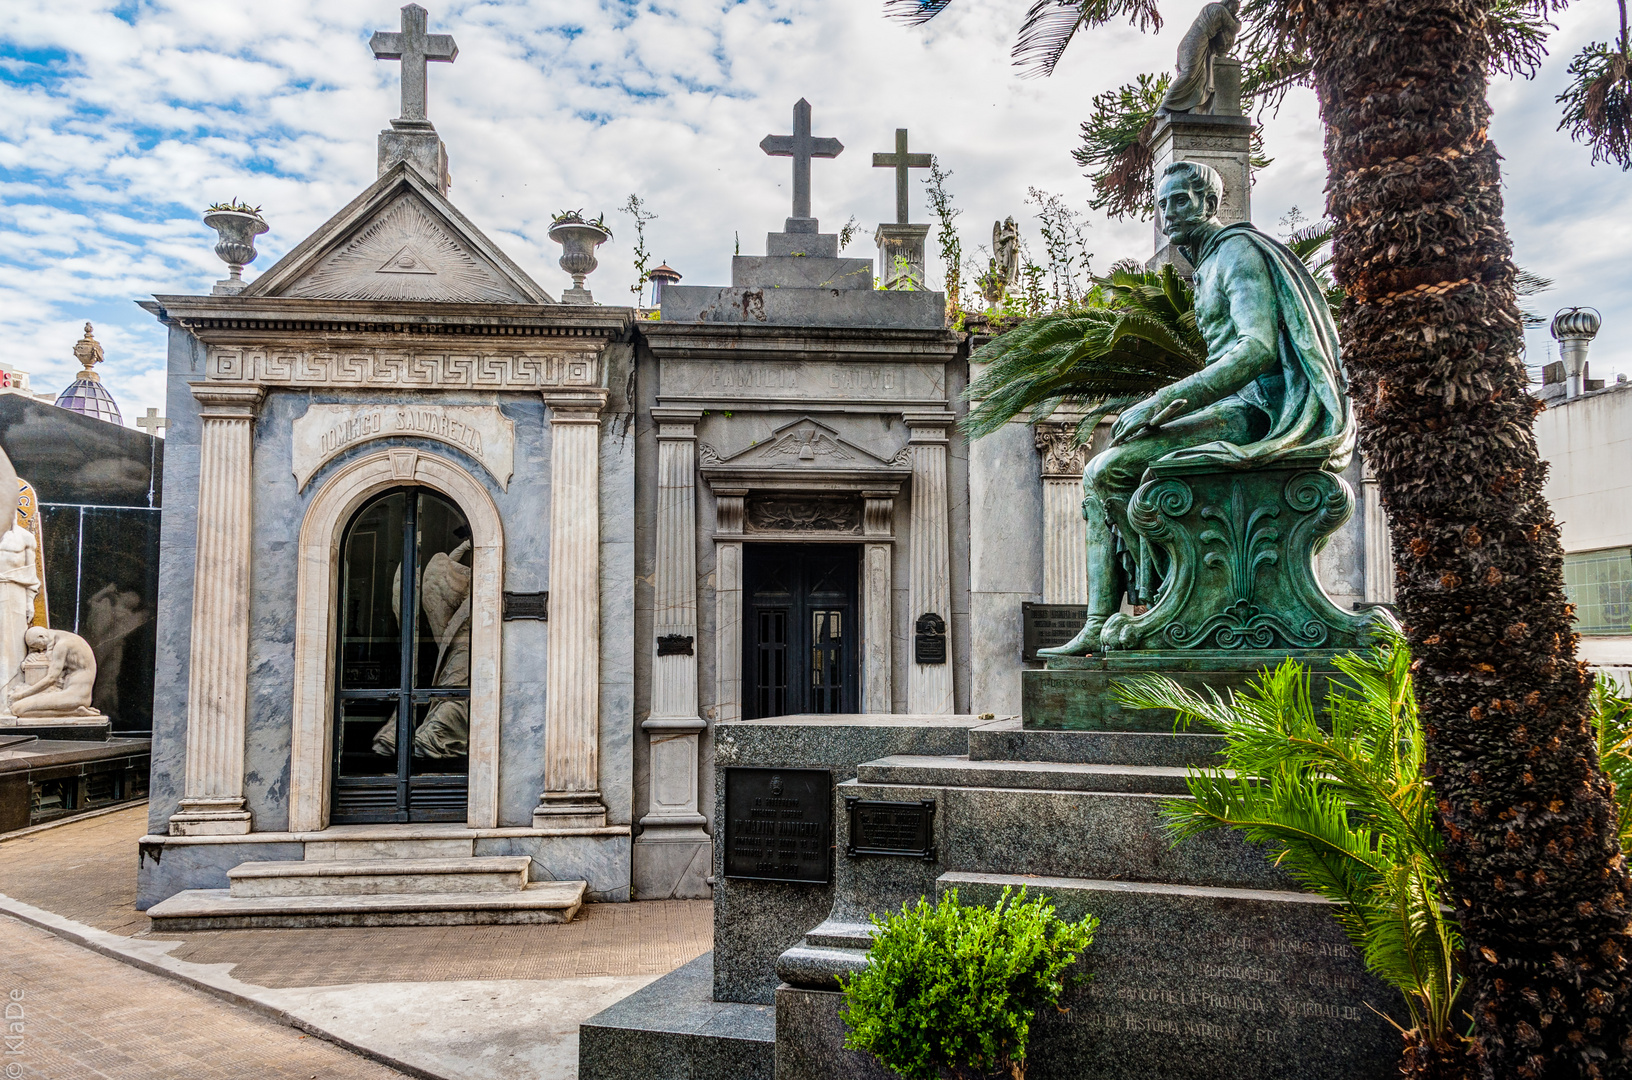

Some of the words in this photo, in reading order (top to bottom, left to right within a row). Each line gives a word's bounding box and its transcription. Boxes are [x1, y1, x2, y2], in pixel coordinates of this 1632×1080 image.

[710, 368, 799, 389] FAMILIA
[321, 413, 381, 458] DOMINGO
[396, 411, 483, 457] SALVAREZZA
